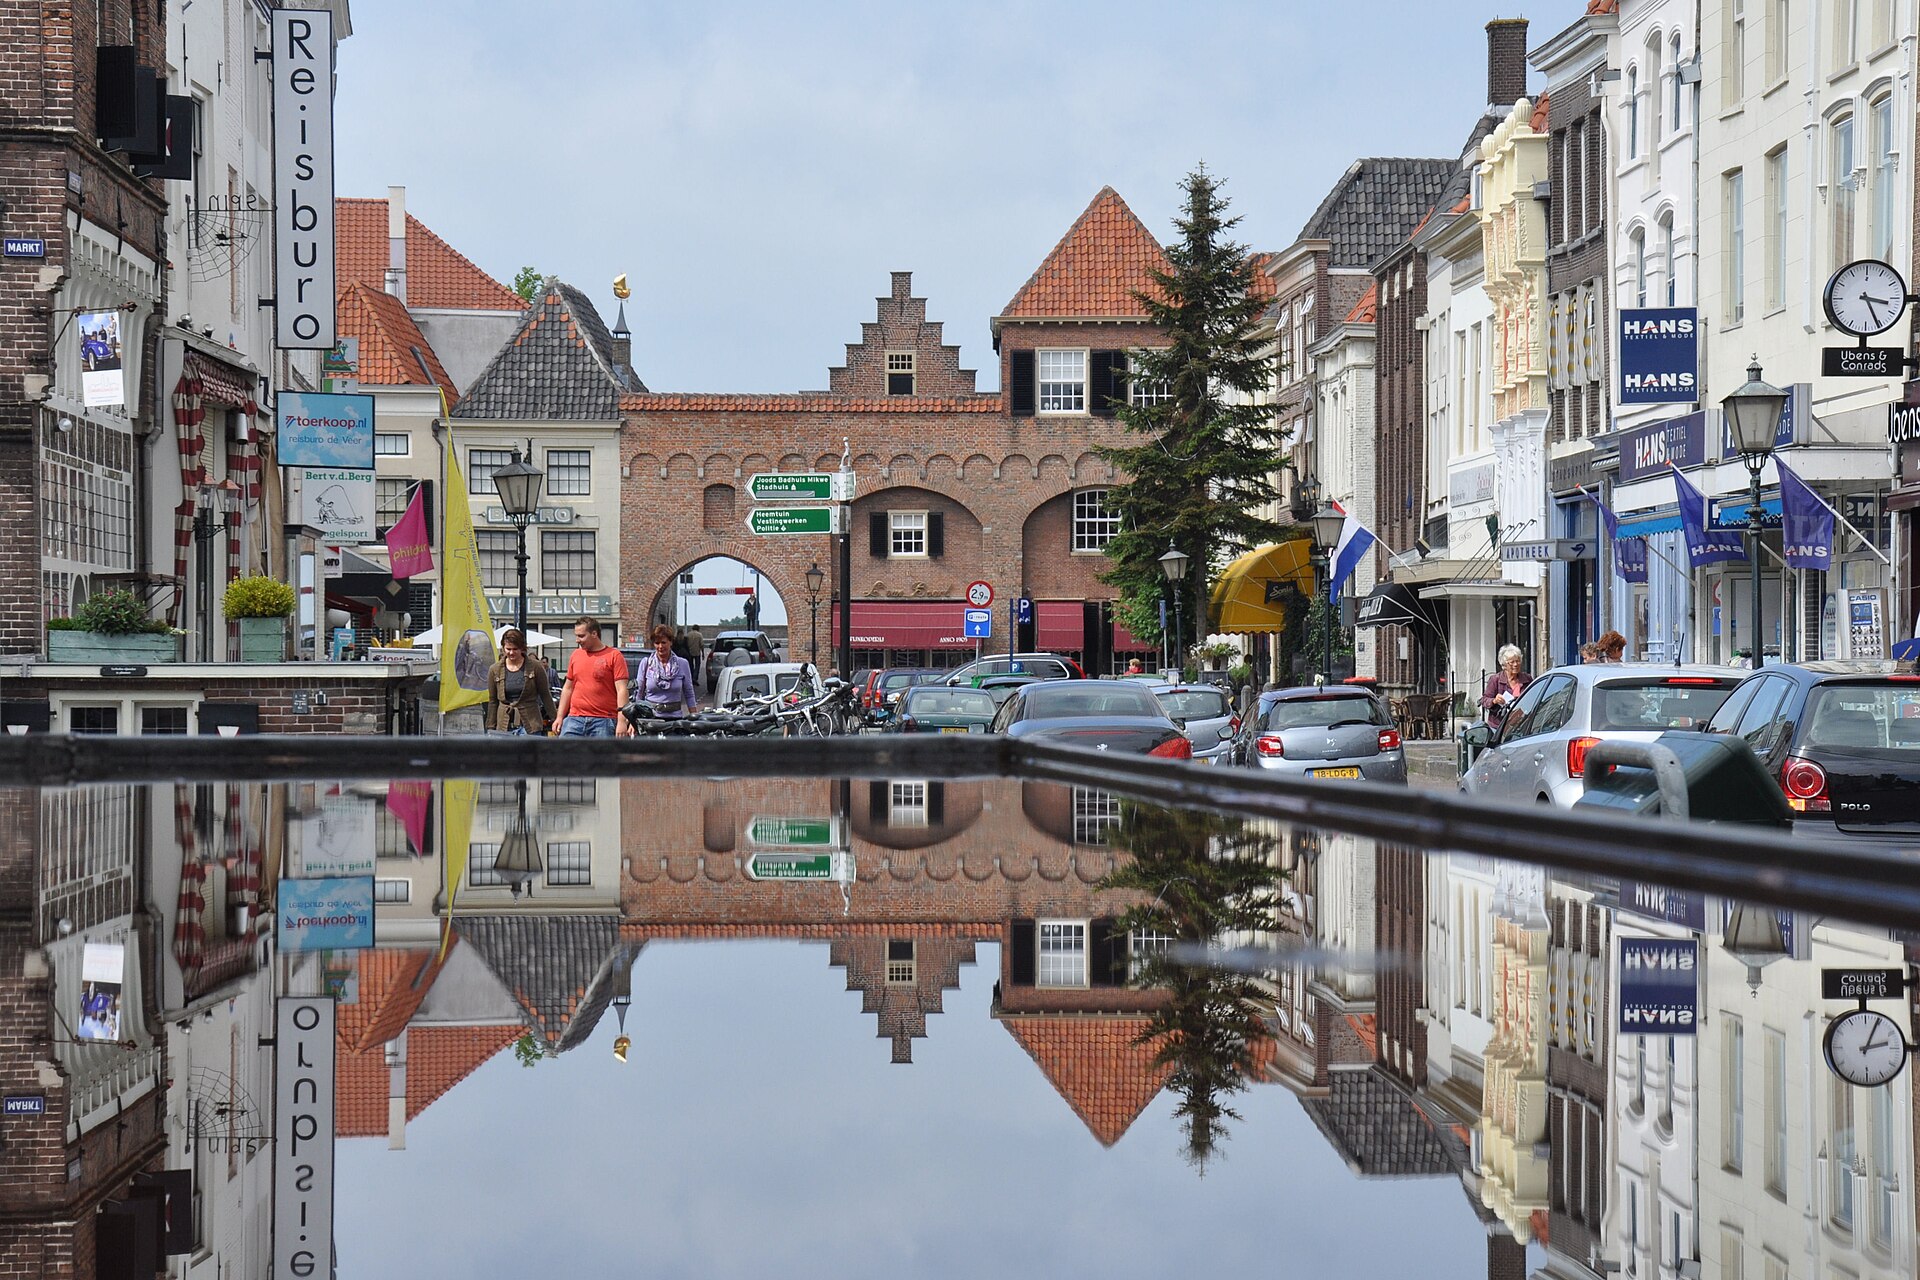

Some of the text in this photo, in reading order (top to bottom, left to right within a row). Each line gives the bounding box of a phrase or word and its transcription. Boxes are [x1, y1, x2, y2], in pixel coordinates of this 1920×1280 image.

[287, 19, 321, 341] Reisburo
[7, 242, 40, 253] MARKT
[1624, 319, 1694, 334] HANS
[1841, 350, 1887, 360] Ubens &
[1841, 360, 1887, 373] Conrads
[1625, 373, 1694, 387] HANS
[297, 415, 367, 430] toerkoop.nl
[288, 434, 362, 445] reisburo de Veer
[1667, 425, 1686, 443] TEXTIEL
[1635, 430, 1666, 470] HANS
[305, 471, 328, 480] Bert
[756, 517, 807, 525] Vestingwerken
[324, 529, 368, 539] ngelsport
[393, 543, 428, 562] phildar
[1506, 545, 1549, 559] APOTHEEK
[1692, 544, 1744, 557] HANS
[1020, 599, 1030, 613] P
[1011, 663, 1018, 671] P
[1840, 803, 1871, 811] POLO
